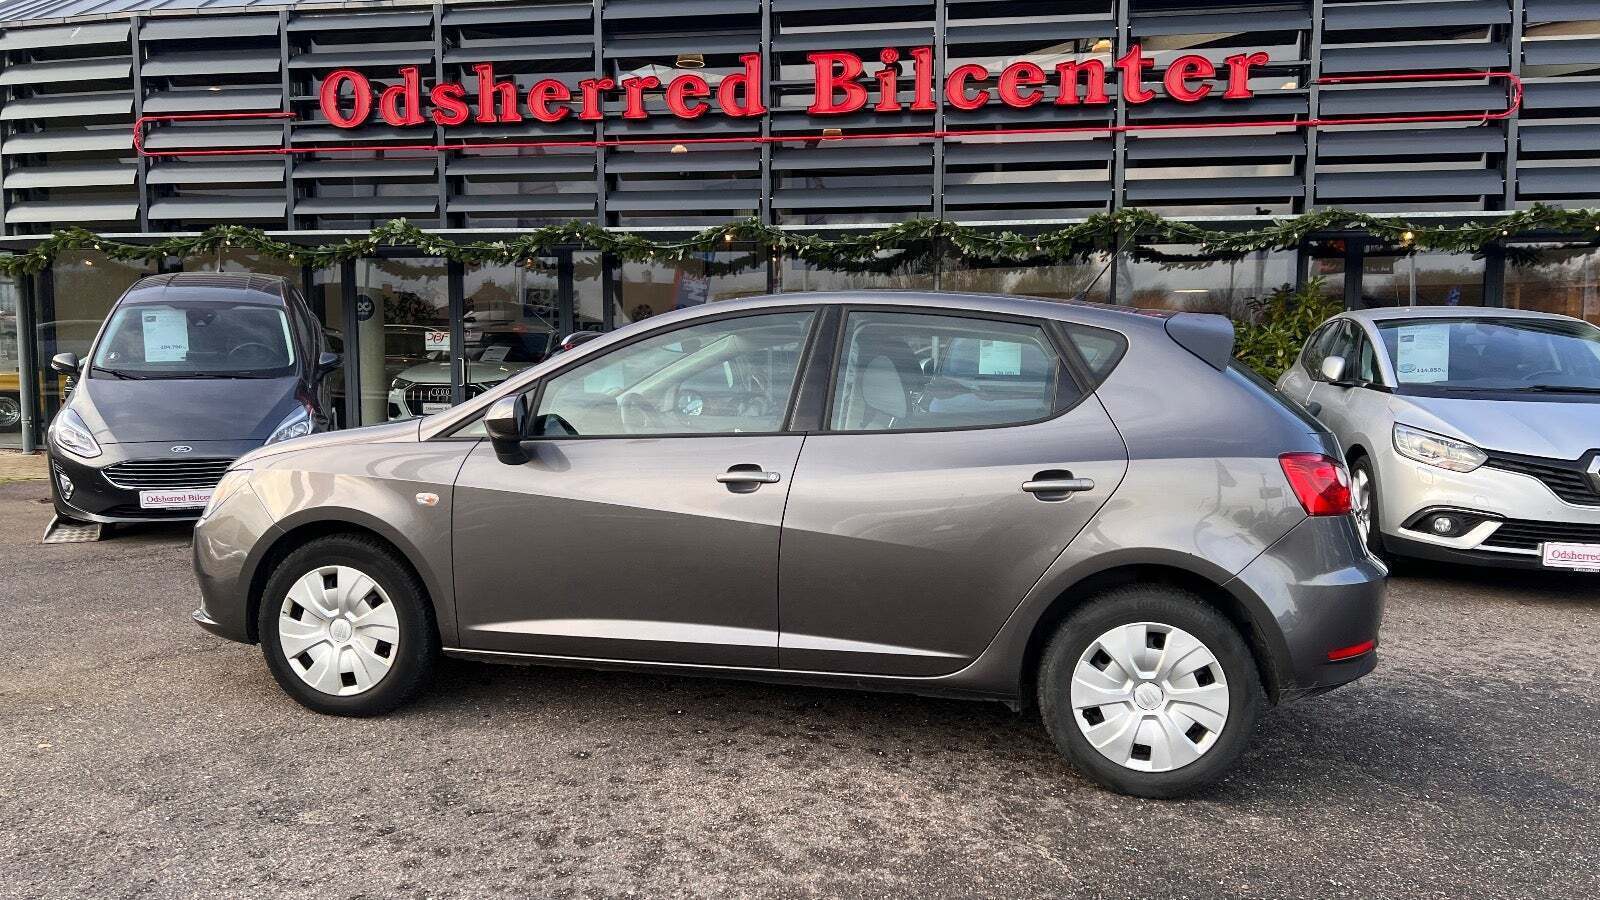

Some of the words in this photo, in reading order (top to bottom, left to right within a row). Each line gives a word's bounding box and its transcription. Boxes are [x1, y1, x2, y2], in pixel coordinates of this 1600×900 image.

[319, 51, 767, 129] Odsherred
[805, 43, 1269, 117] Bilcenter
[146, 494, 186, 503] Odsherred
